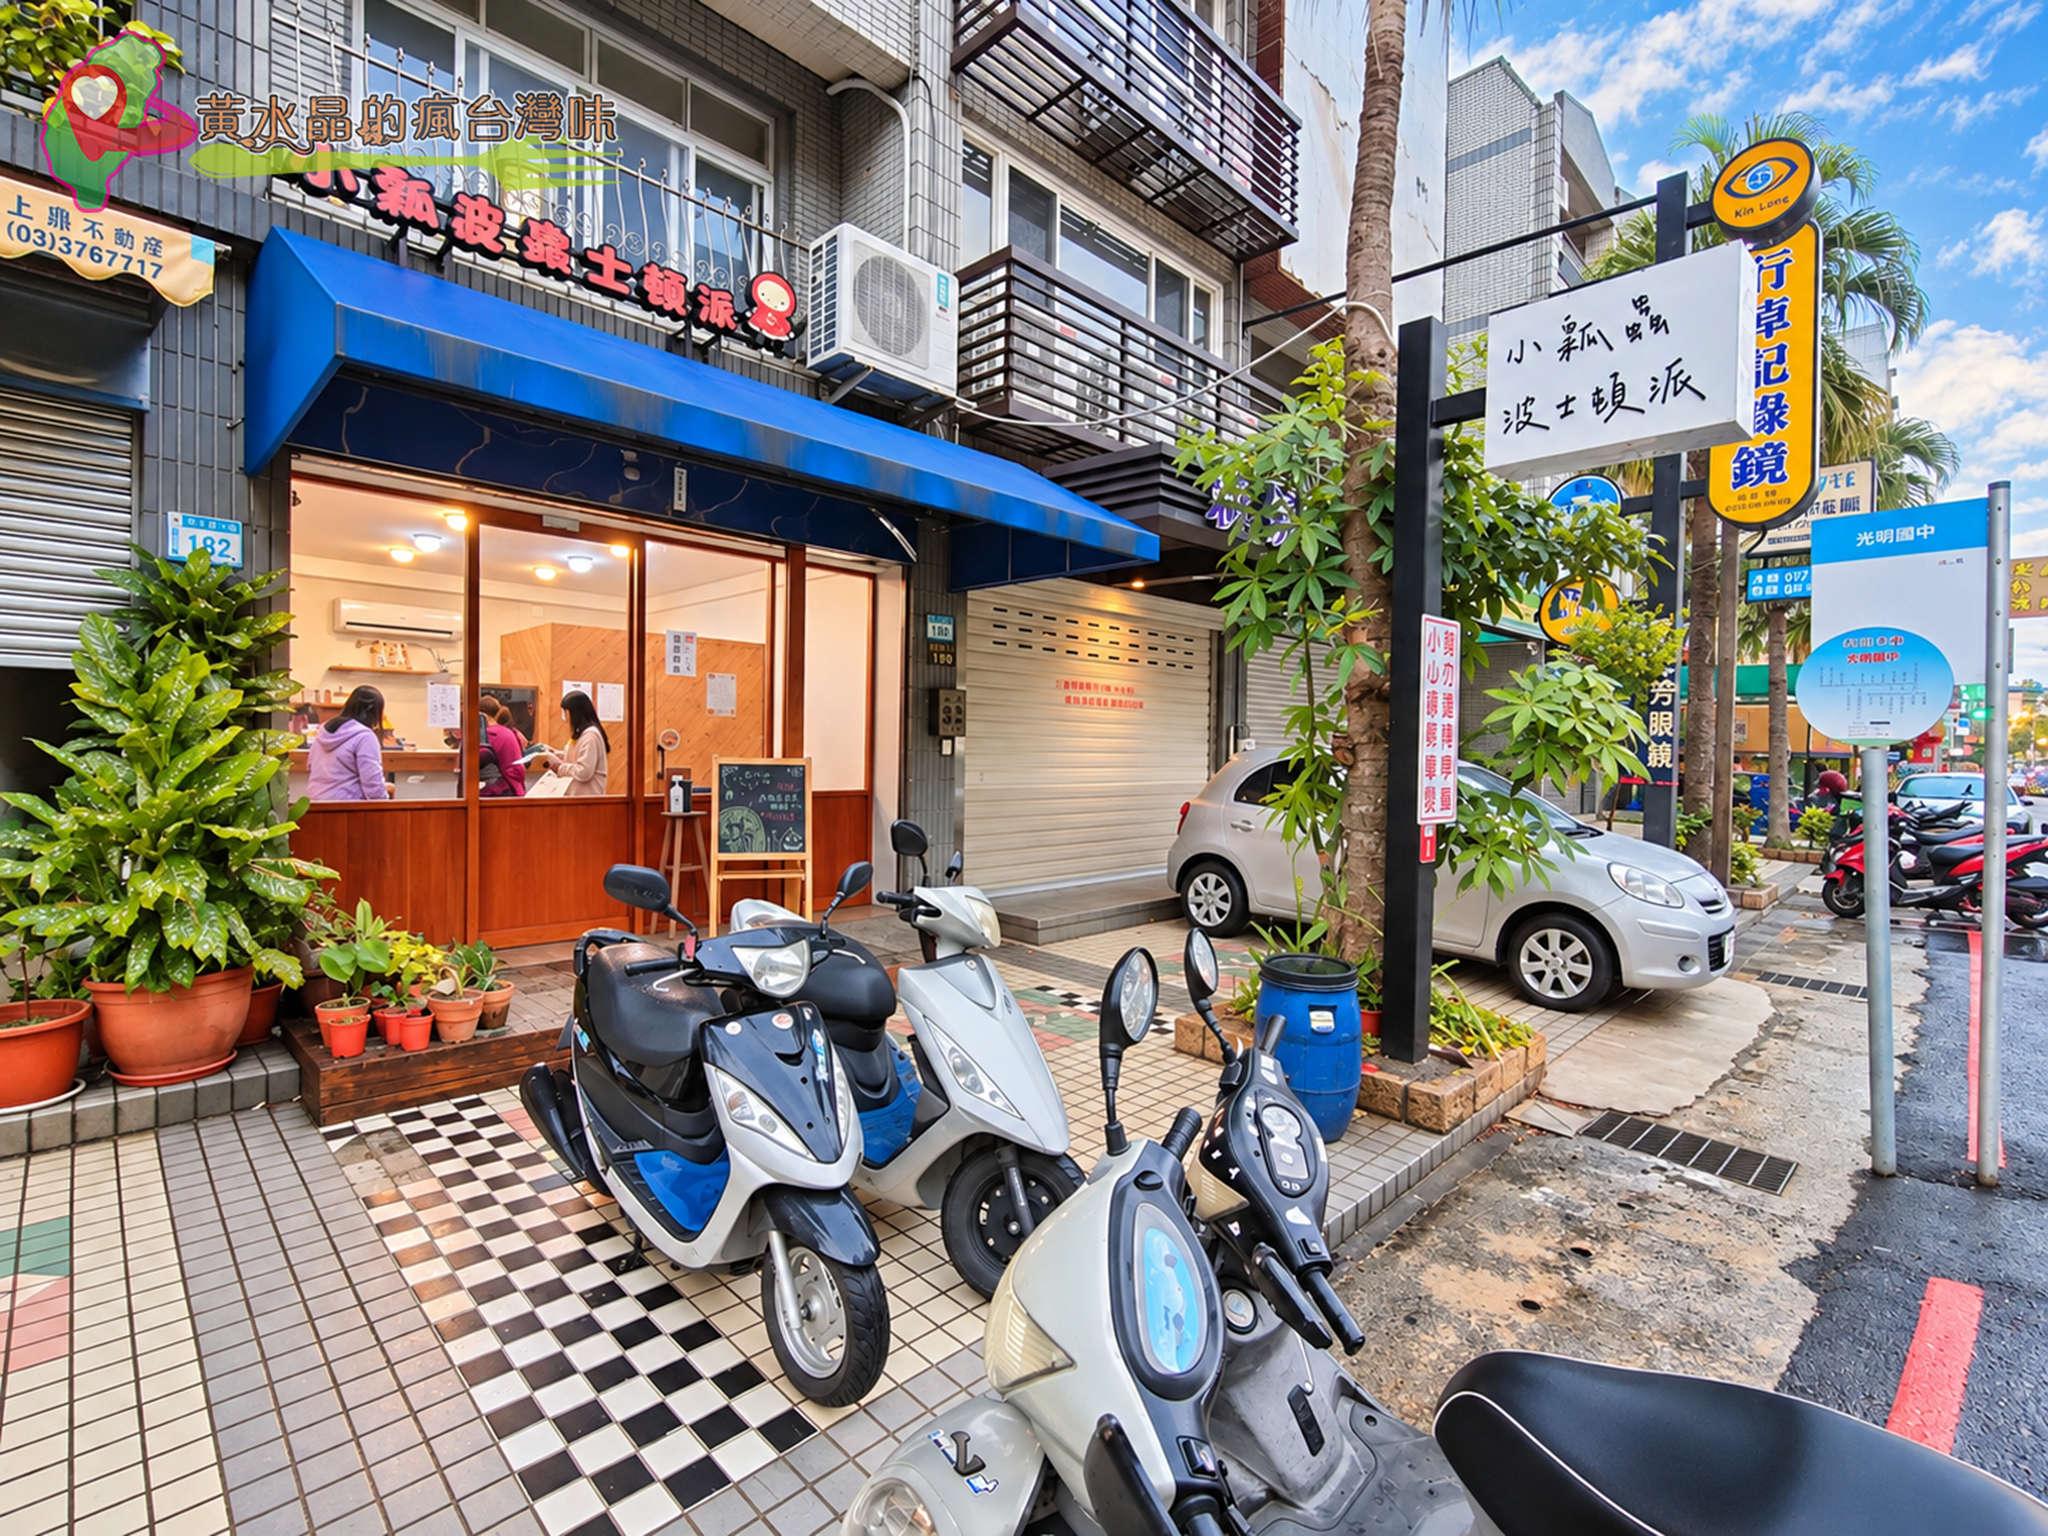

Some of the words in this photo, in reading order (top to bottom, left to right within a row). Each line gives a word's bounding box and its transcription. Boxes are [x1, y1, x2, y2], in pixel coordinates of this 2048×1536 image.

[7, 220, 164, 280] (03)3767717
[1503, 357, 1706, 434] 波士頓派
[188, 534, 231, 558] 182
[1856, 523, 1936, 547] 光明國中
